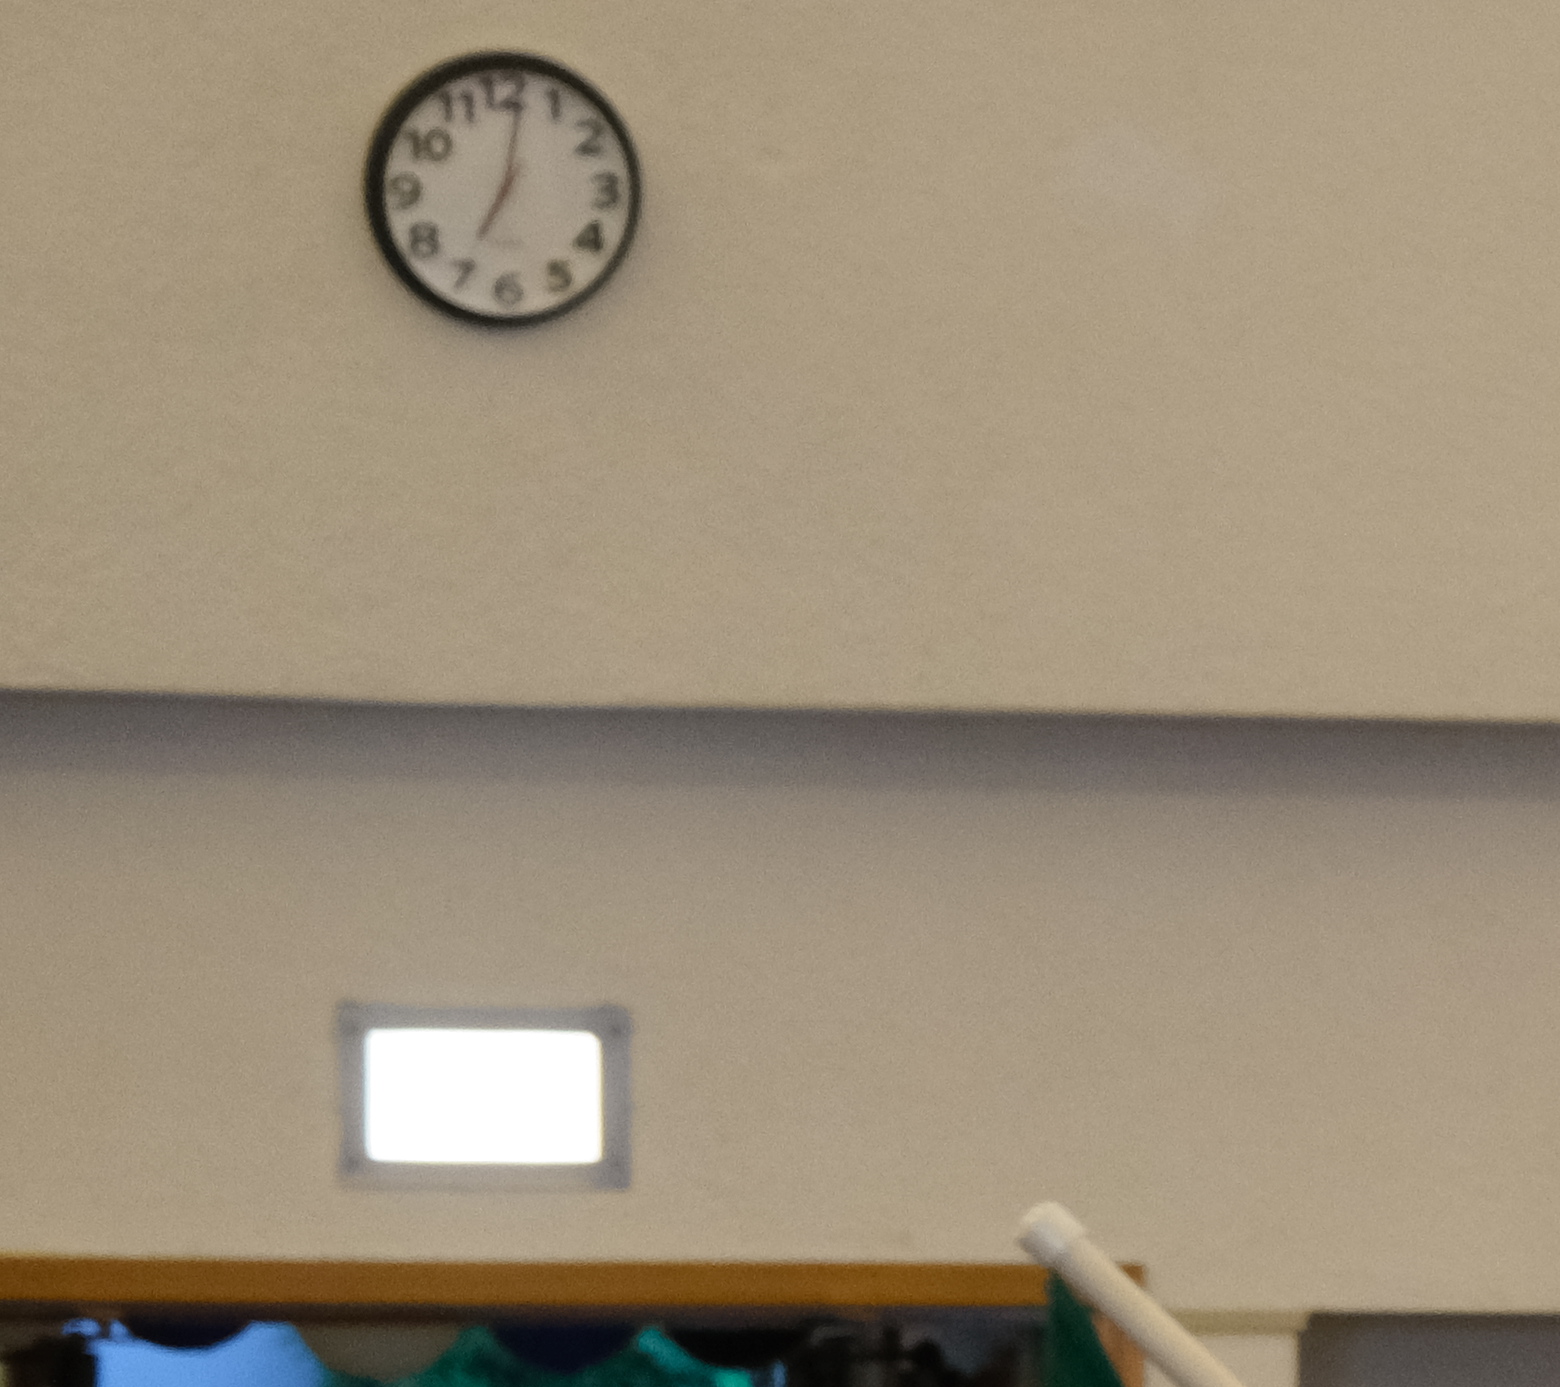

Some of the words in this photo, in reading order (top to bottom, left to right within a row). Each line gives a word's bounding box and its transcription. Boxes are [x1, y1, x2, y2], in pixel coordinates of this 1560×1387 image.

[403, 127, 452, 161] 10
[576, 118, 602, 155] 2
[389, 171, 422, 209] 9
[593, 172, 620, 210] 3
[409, 221, 439, 257] 8
[573, 220, 603, 252] 4
[453, 258, 475, 289] 7
[547, 259, 572, 292] 5
